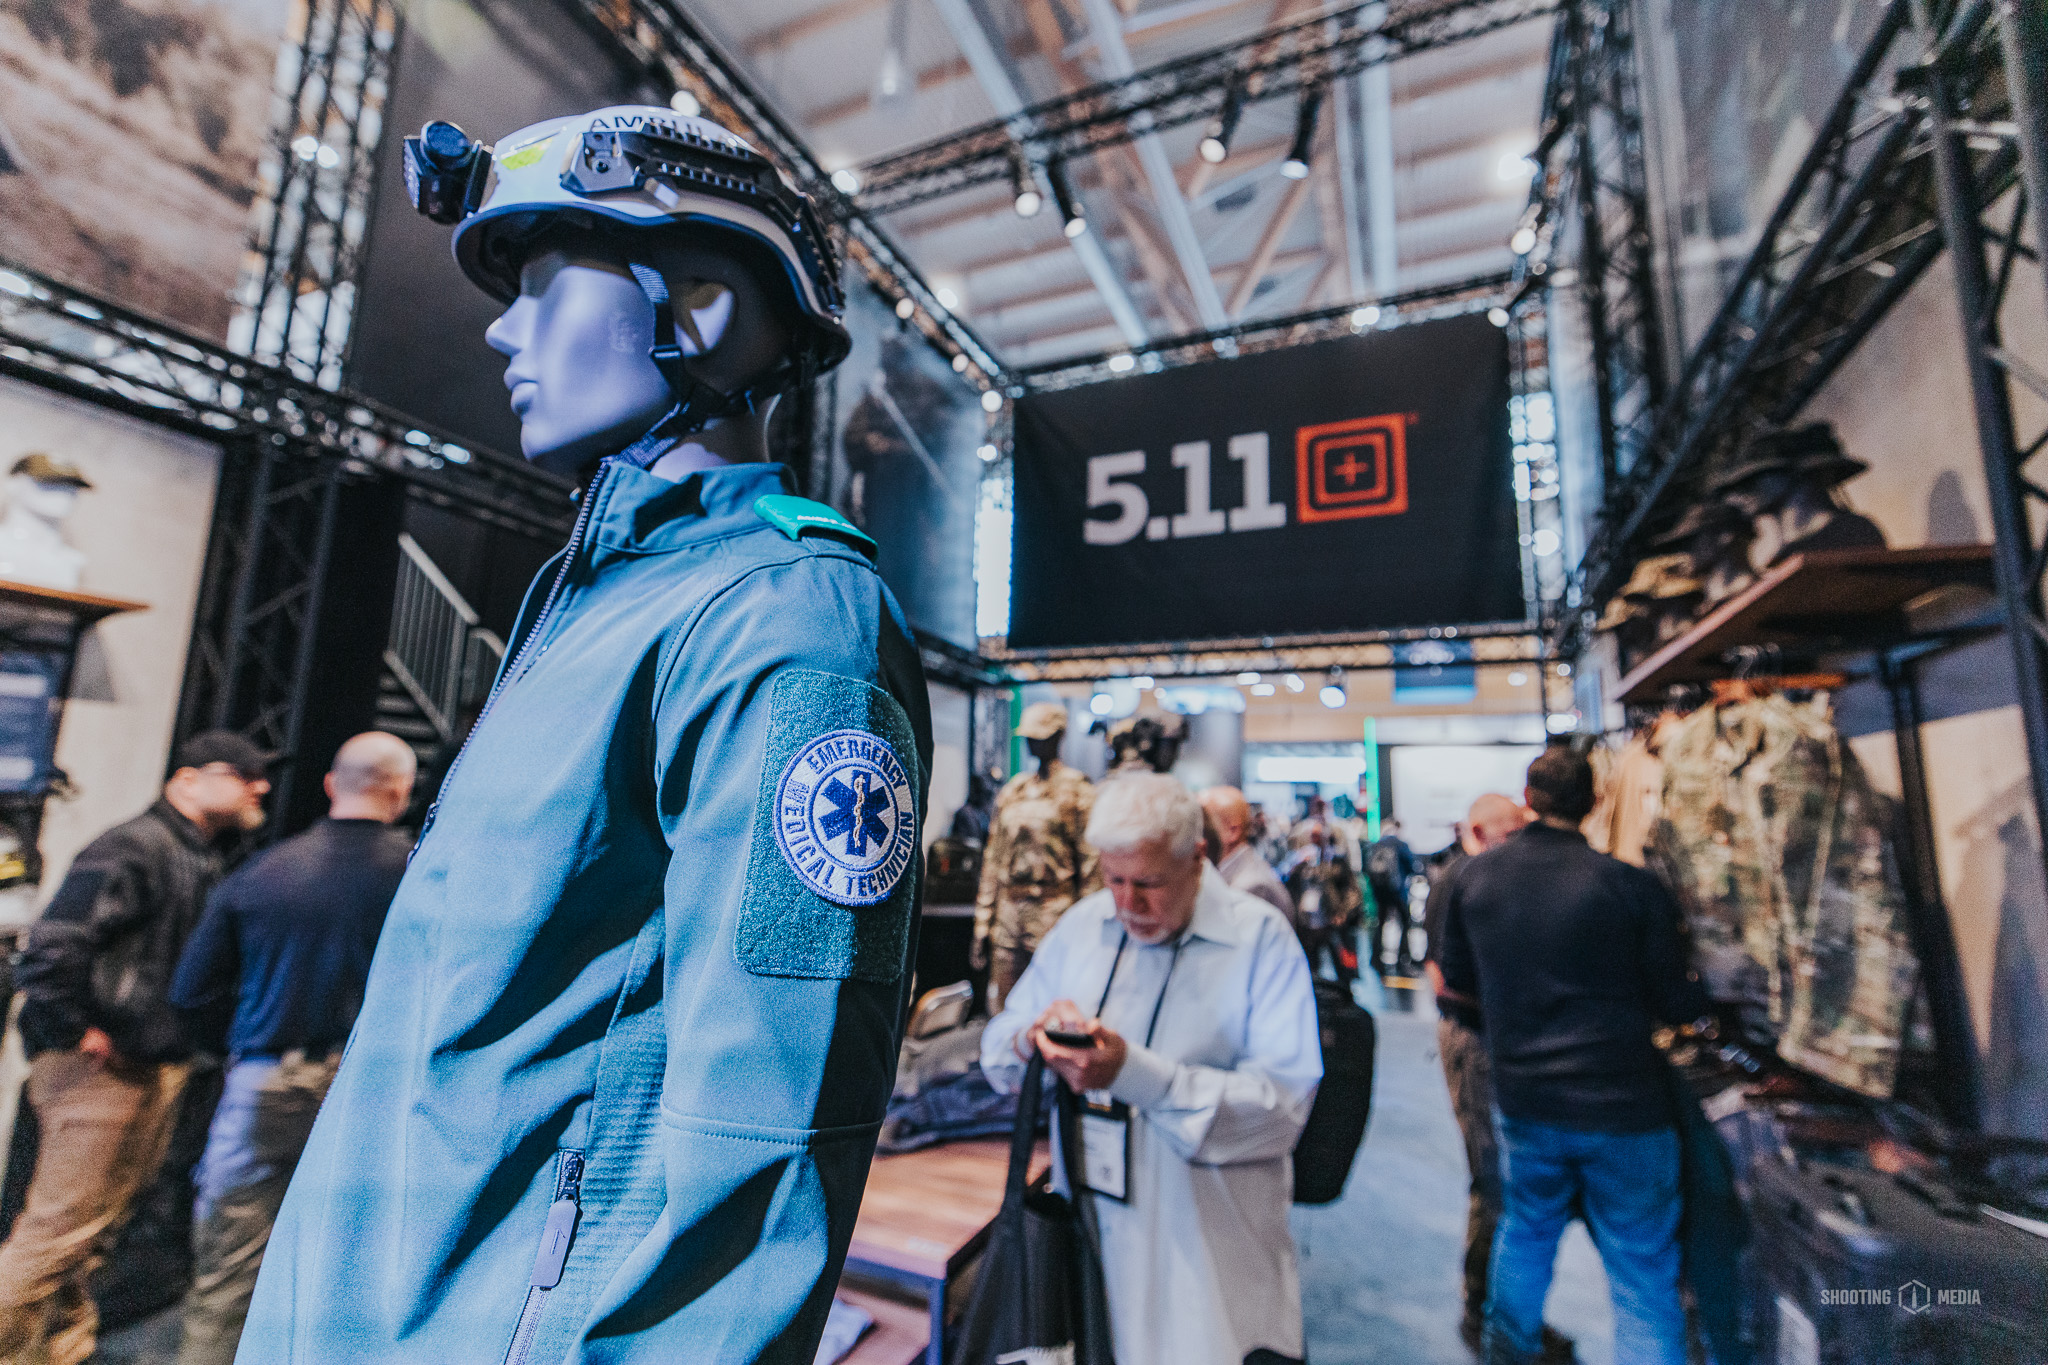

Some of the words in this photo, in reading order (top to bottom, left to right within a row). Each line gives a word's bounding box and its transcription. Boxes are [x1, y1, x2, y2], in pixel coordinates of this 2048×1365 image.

[1083, 431, 1287, 545] 5.11
[806, 738, 907, 789] EMERGENCY
[785, 779, 835, 889] MEDICAL
[845, 811, 914, 897] TECHNICIAN
